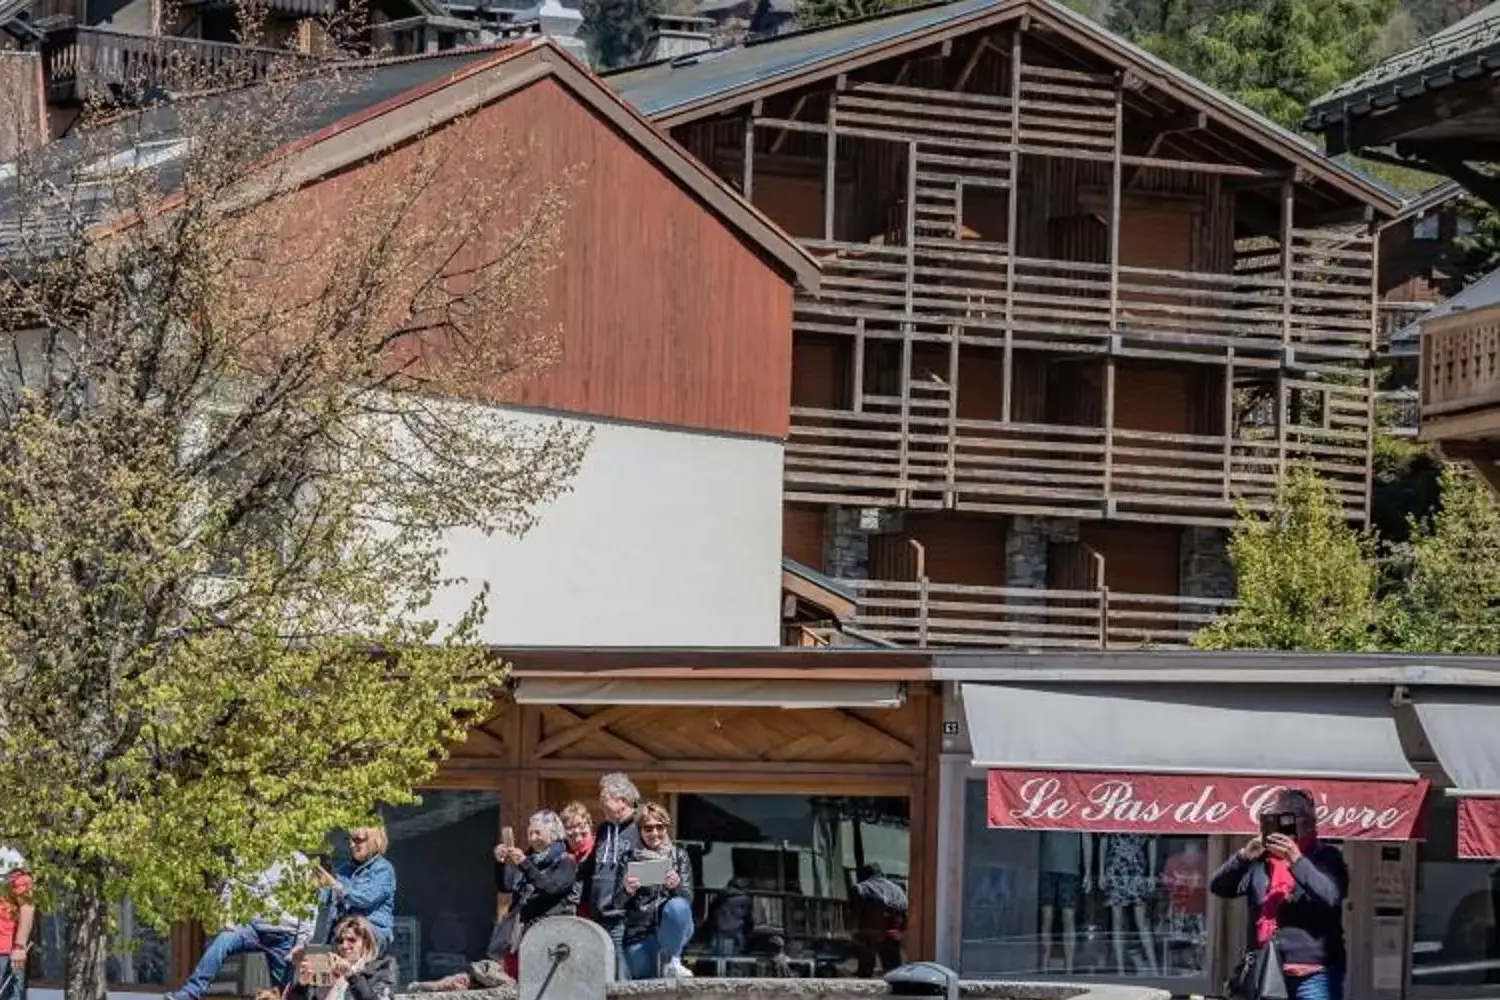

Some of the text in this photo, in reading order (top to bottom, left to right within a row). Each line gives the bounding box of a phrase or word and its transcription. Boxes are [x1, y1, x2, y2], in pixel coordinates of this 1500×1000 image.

[1010, 776, 1412, 830] Le Pas de Cèvre
